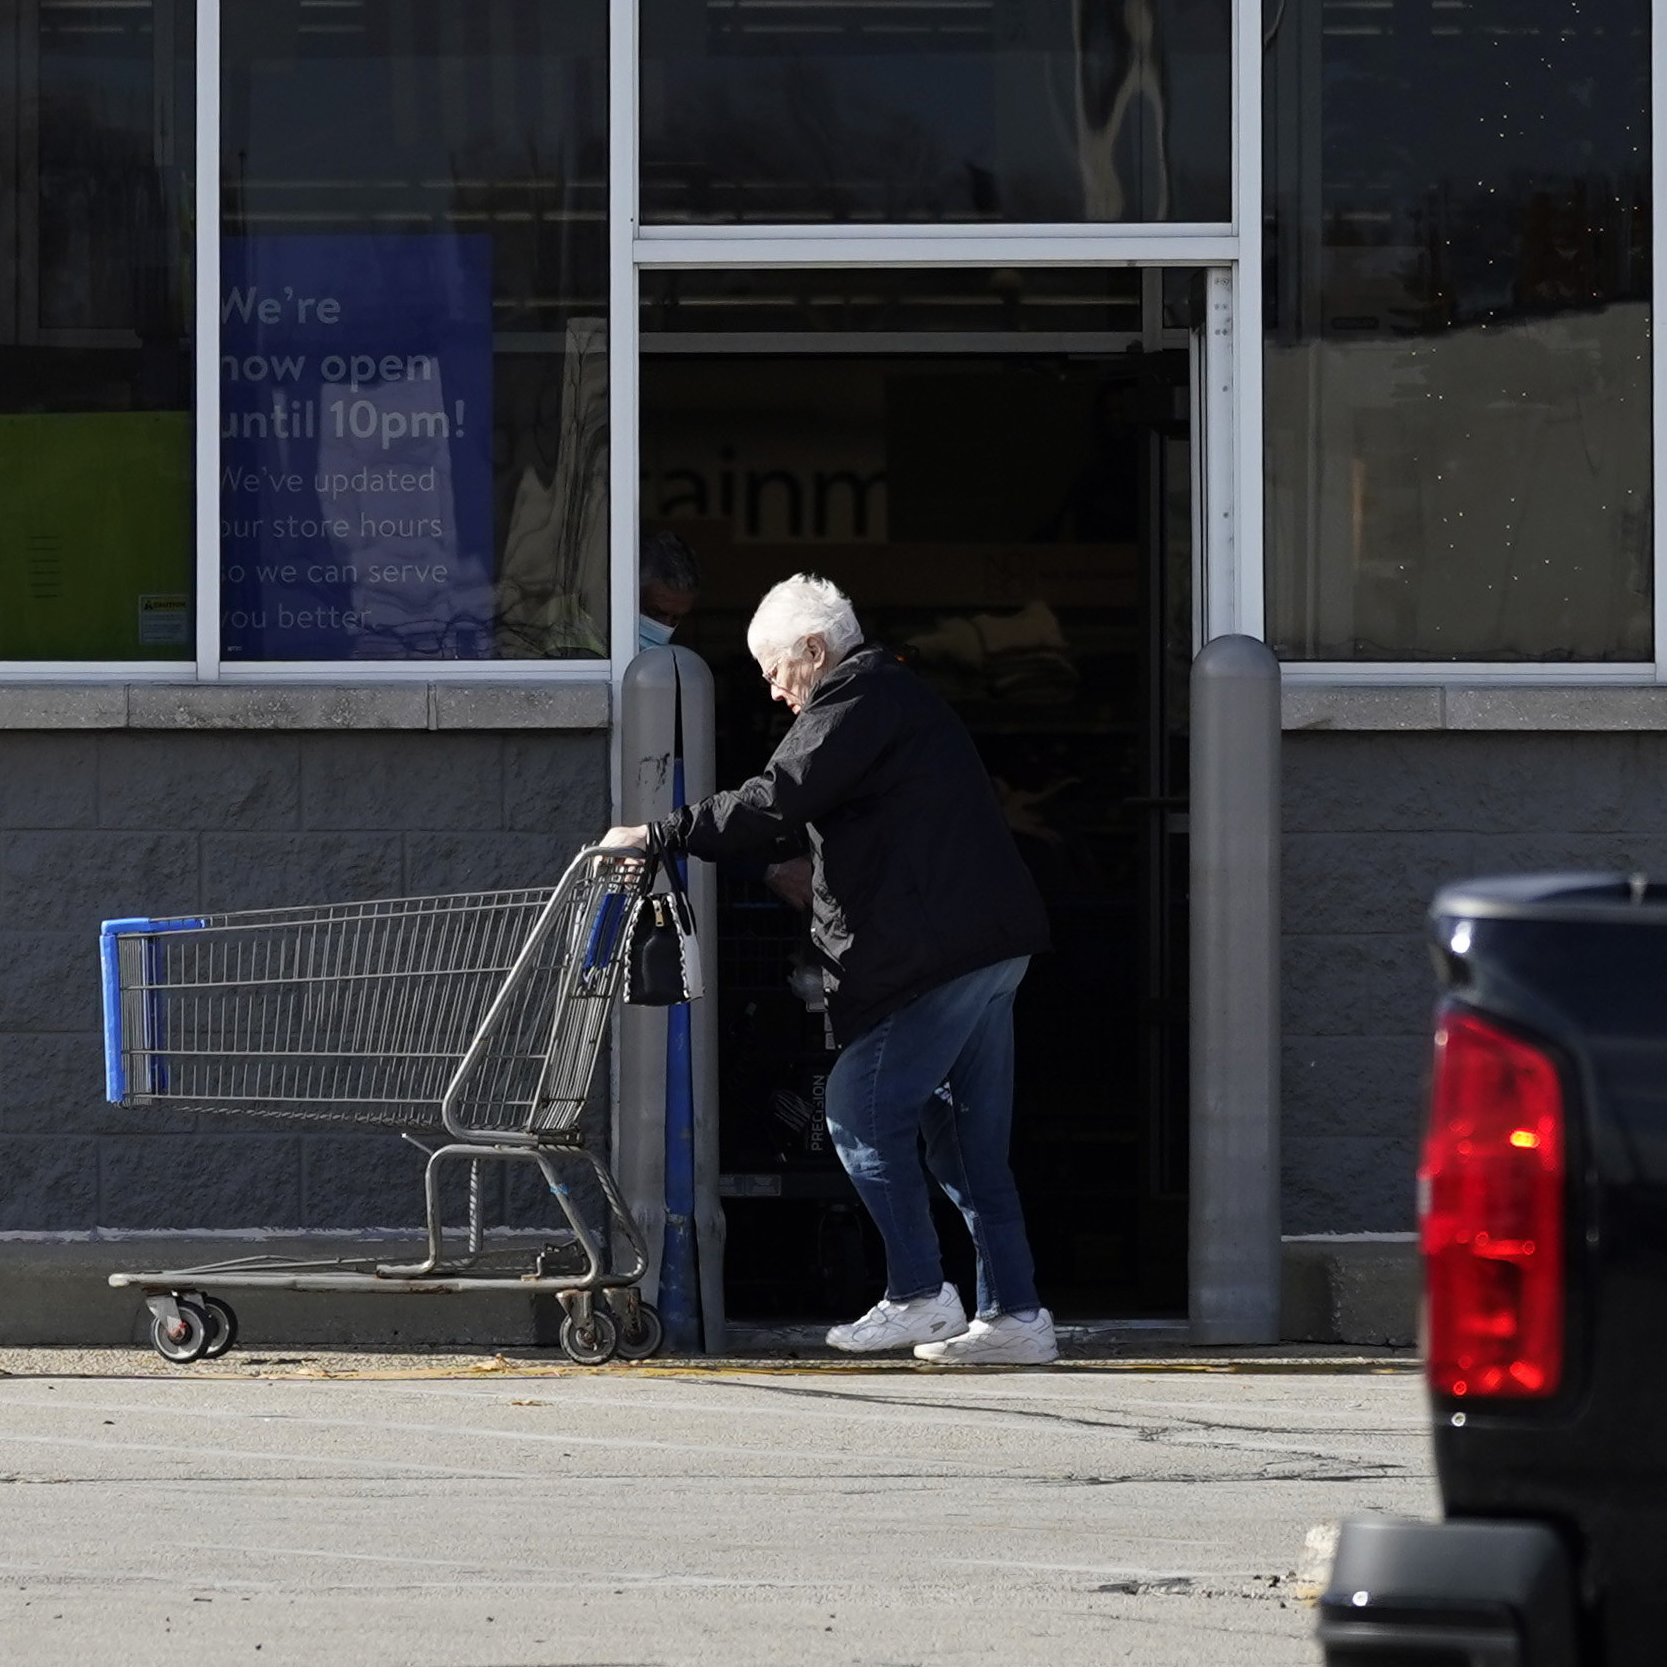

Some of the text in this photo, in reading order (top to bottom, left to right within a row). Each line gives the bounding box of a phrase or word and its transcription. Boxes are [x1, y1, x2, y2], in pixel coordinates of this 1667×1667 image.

[220, 286, 341, 325] We're
[320, 355, 432, 393] open
[331, 399, 465, 450] 10pm!
[220, 466, 434, 501] We've updated
[272, 517, 350, 539] store
[360, 512, 443, 539] hours
[256, 564, 298, 584] we
[306, 564, 358, 584] can
[367, 564, 449, 584] serve
[811, 1074, 826, 1152] PRECISION
